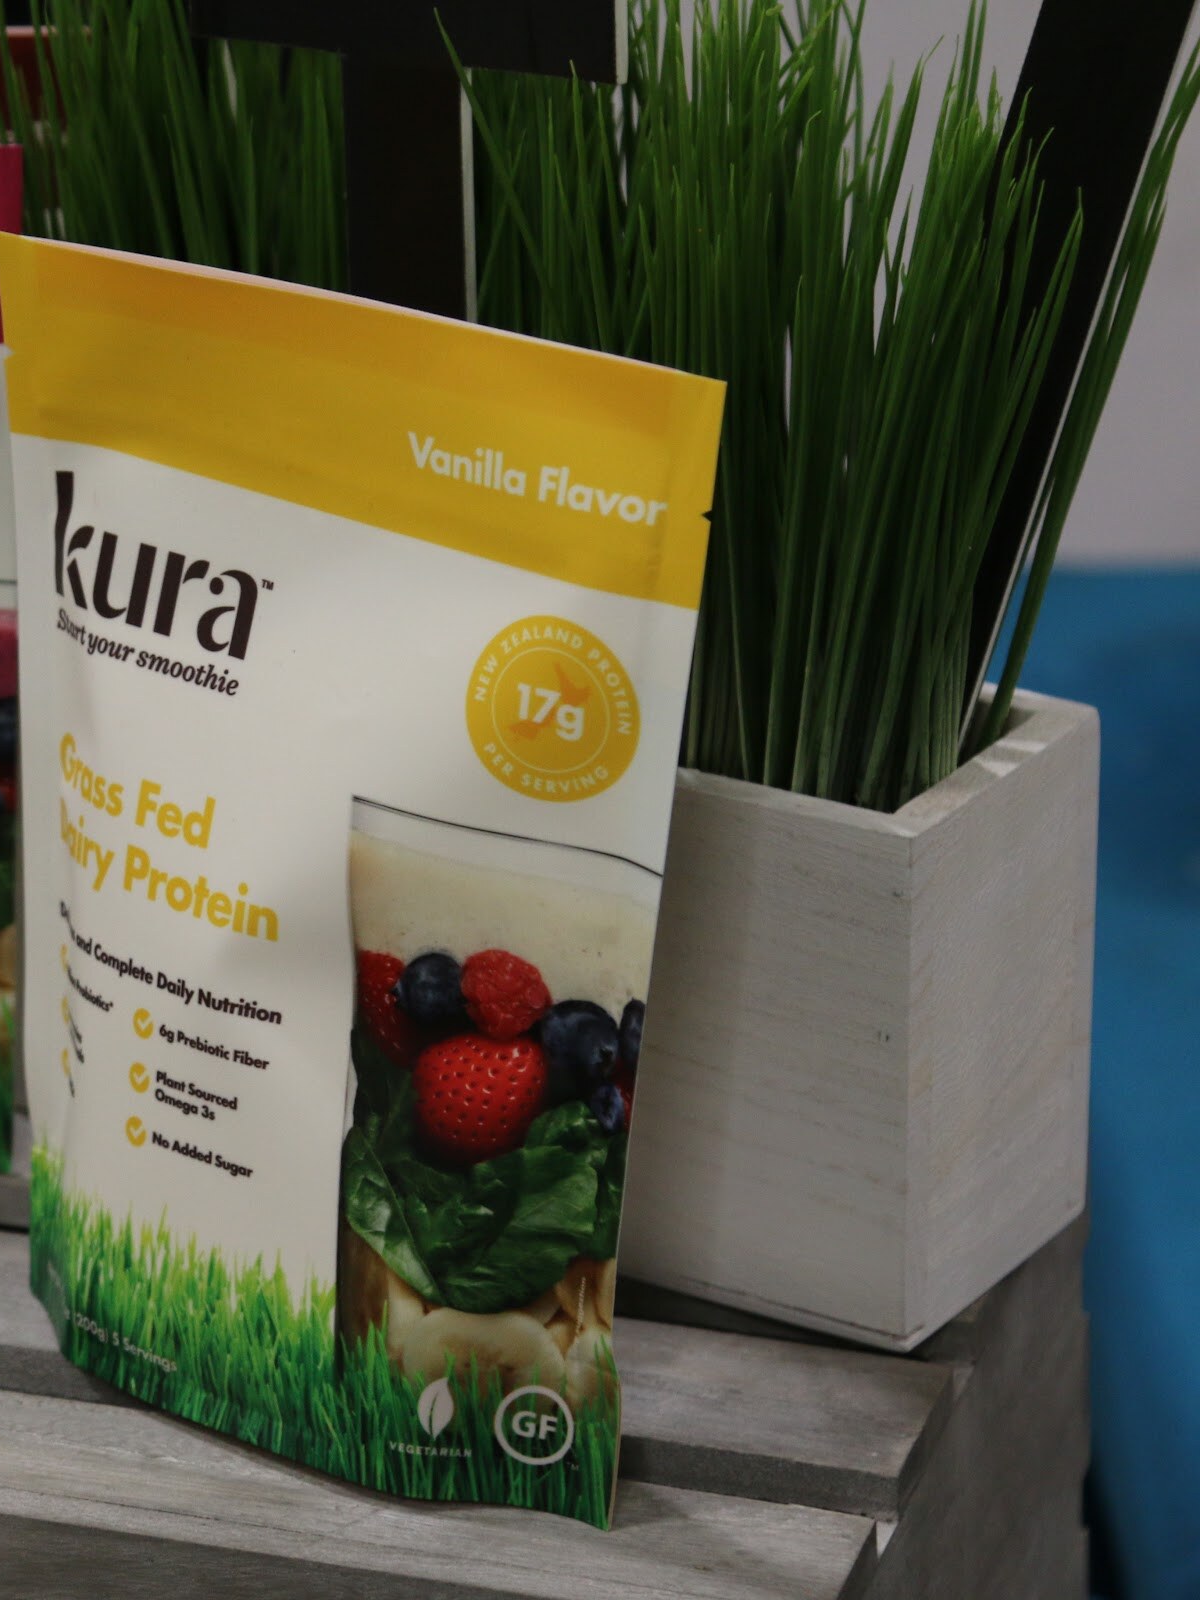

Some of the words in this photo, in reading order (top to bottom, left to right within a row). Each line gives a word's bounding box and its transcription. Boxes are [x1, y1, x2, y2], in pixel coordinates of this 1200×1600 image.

[408, 431, 526, 496] Vanilla
[538, 466, 668, 526] Flavor
[88, 632, 135, 662] your
[136, 650, 239, 696] smoothie
[475, 655, 498, 701] NEW
[501, 625, 583, 653] ZEALAND
[587, 649, 632, 735] PROTEIN
[518, 683, 585, 741] 17g
[60, 733, 124, 817] Grass
[135, 779, 216, 849] Fed
[484, 742, 514, 776] PER
[521, 766, 609, 793] SERVING
[123, 844, 279, 942] Protein
[76, 936, 93, 955] and
[94, 944, 153, 984] Complete
[156, 972, 194, 1005] Daily
[197, 989, 282, 1024] Nutrition
[159, 1025, 174, 1043] 6g
[177, 1031, 230, 1060] Prebiotic
[232, 1050, 269, 1070] Fiber
[155, 1089, 198, 1115] Omega
[201, 1105, 215, 1120] 3s
[156, 1071, 186, 1092] Plant
[188, 1083, 238, 1110] Sourced
[152, 1131, 169, 1149] No
[172, 1140, 212, 1164] Added
[215, 1154, 253, 1178] Sugar
[123, 1336, 177, 1373] Servings
[389, 1441, 472, 1457] VEGETARIAN
[512, 1410, 558, 1440] GF
